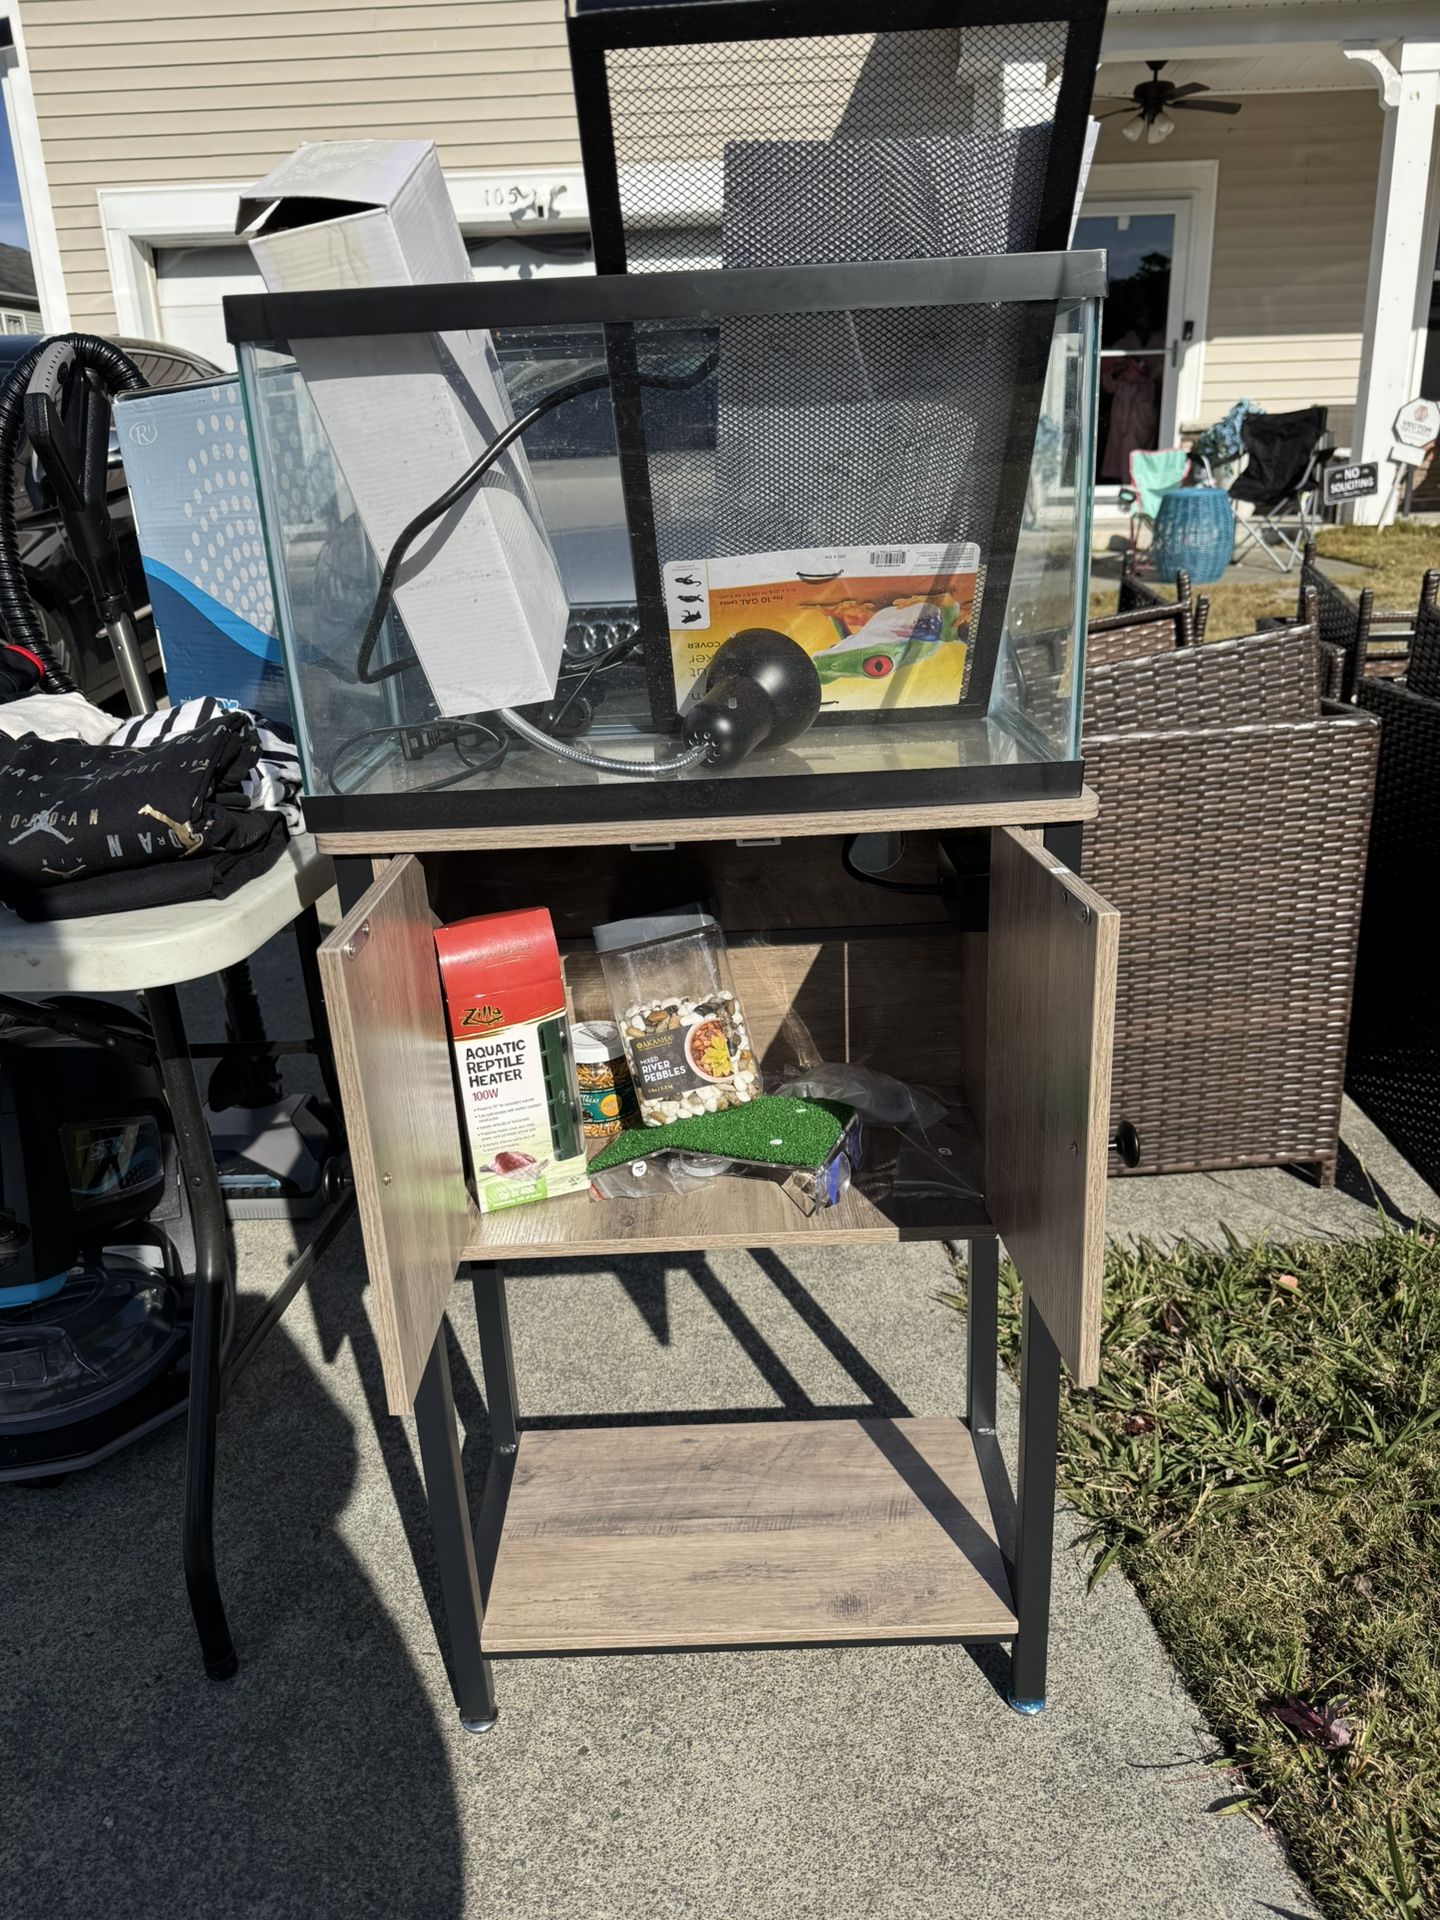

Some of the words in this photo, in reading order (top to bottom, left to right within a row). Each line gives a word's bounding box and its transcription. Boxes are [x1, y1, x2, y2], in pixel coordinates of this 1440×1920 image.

[1344, 467, 1360, 480] NO
[1330, 477, 1374, 494] SOLICITING
[739, 597, 759, 606] GAL
[687, 641, 721, 649] COVER
[462, 1006, 504, 1027] Zilla
[466, 1040, 526, 1061] AQUATIC
[466, 1054, 525, 1075] REPTILE
[640, 1056, 659, 1065] MIXED
[641, 1060, 671, 1074] RIVER
[468, 1068, 523, 1088] HEATER
[644, 1065, 687, 1083] PEBBLES
[472, 1088, 499, 1102] 100W
